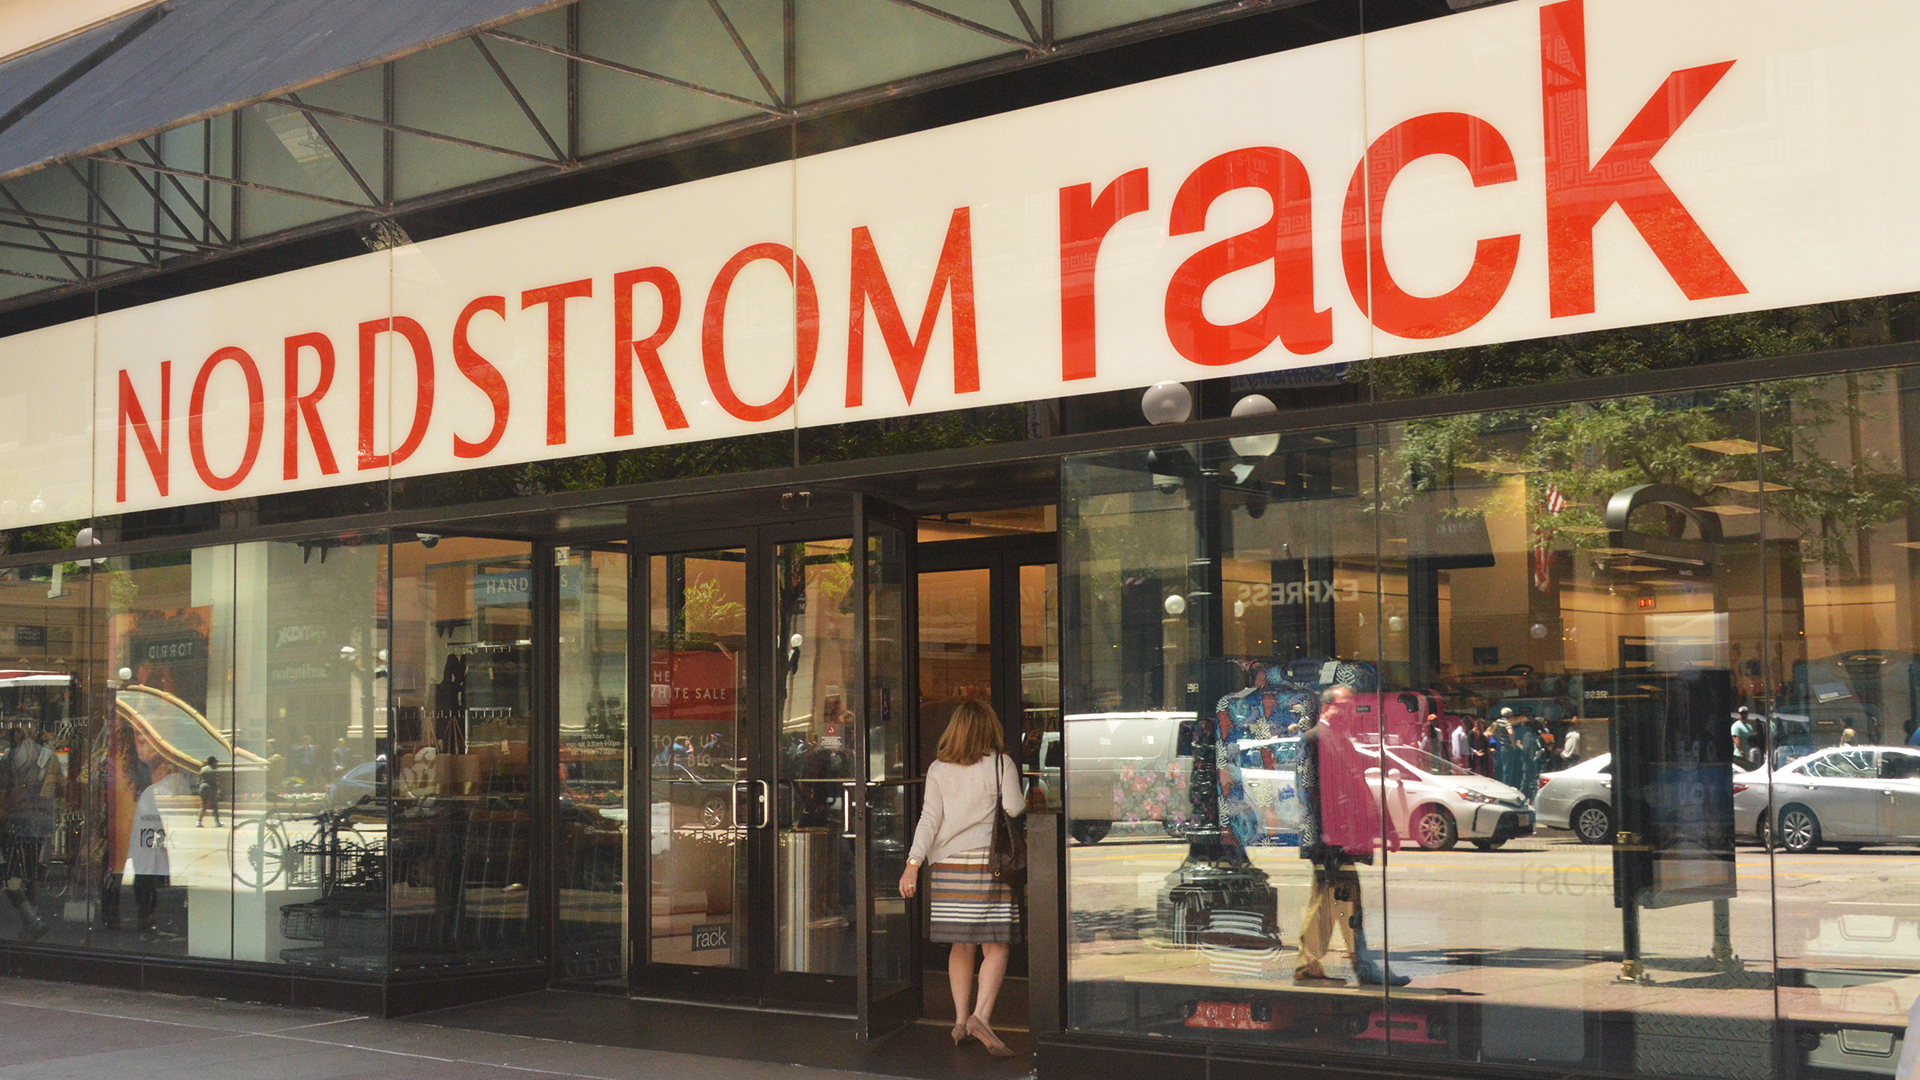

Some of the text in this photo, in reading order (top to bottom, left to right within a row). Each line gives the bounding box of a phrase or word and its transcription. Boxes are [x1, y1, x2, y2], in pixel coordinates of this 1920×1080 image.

[116, 0, 1750, 503] NORDSTROM rack
[653, 670, 671, 682] HE
[695, 688, 726, 700] SALE
[653, 754, 682, 767] AVE
[696, 926, 727, 948] rack
[1640, 1038, 1762, 1059] TIMBERLAND
